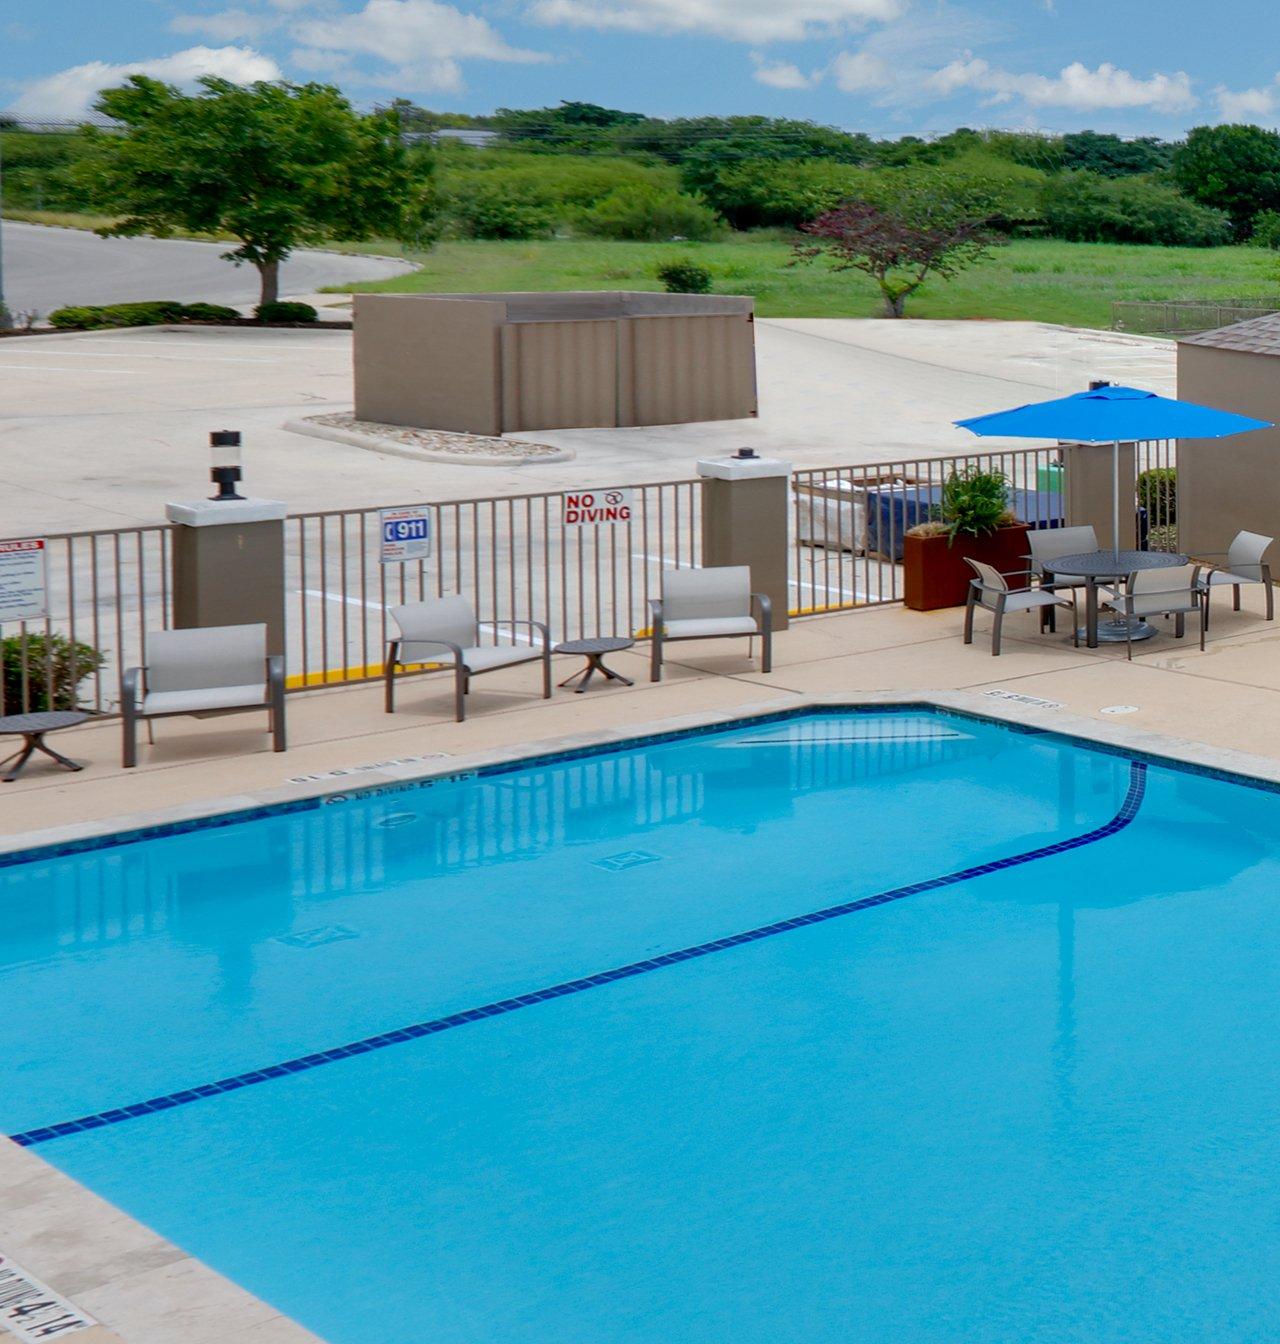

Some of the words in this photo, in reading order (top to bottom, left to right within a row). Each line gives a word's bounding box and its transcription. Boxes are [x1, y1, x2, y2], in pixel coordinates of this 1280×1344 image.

[567, 494, 594, 509] NO
[566, 506, 630, 523] DIVING
[398, 520, 424, 539] 911
[8, 1301, 57, 1318] 4
